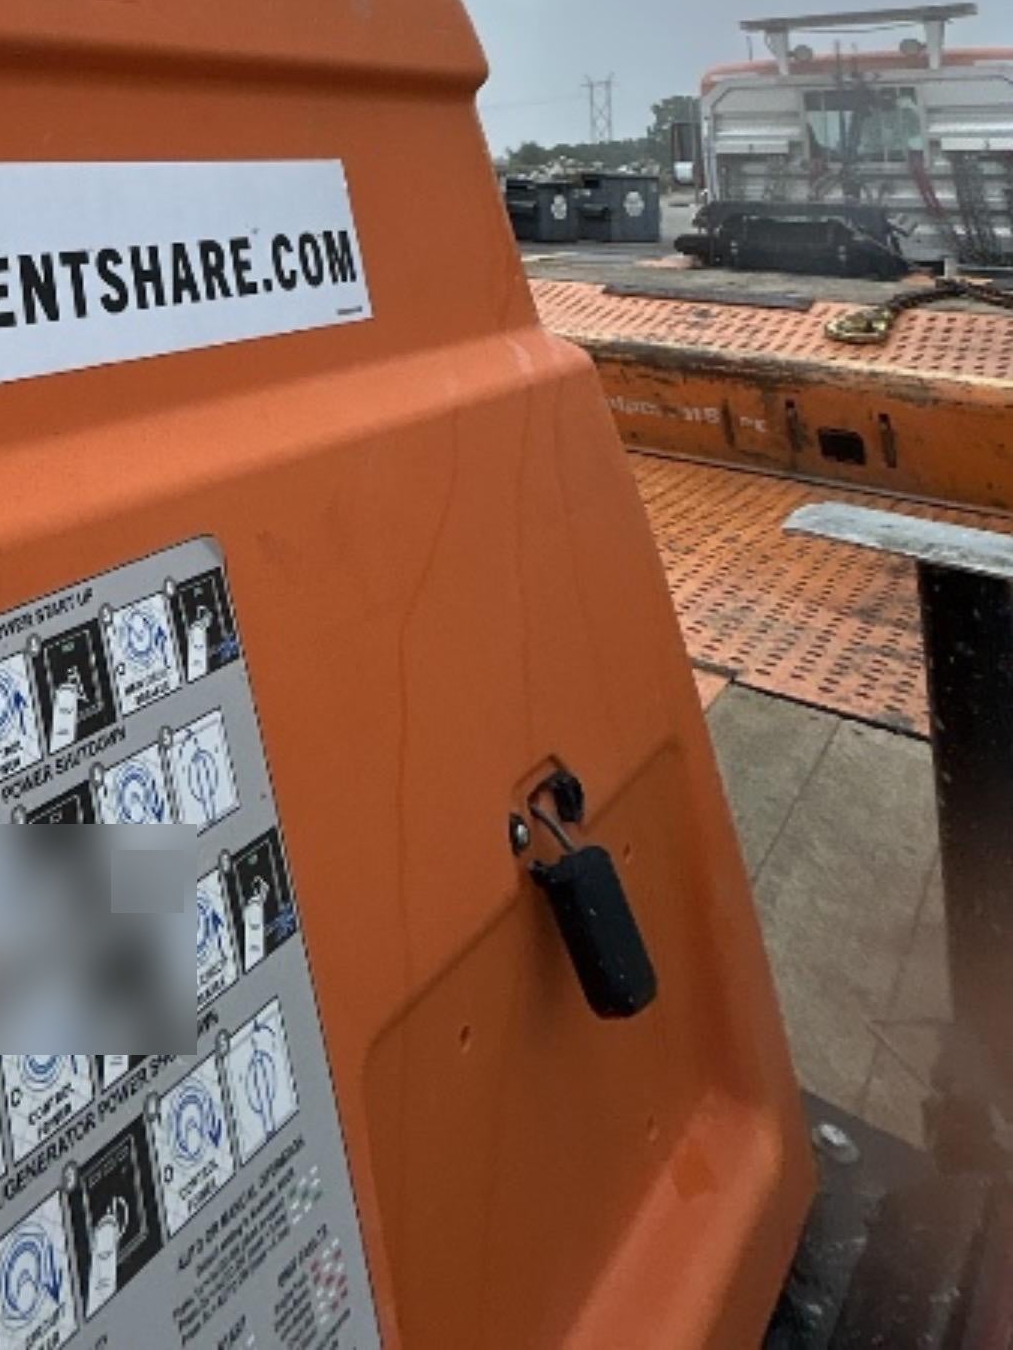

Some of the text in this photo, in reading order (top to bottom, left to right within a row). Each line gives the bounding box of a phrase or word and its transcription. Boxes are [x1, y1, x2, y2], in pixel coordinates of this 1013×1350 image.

[35, 594, 75, 624] START
[77, 587, 93, 606] UP
[4, 1113, 96, 1200] GENERATOR
[97, 1068, 149, 1122] POWER
